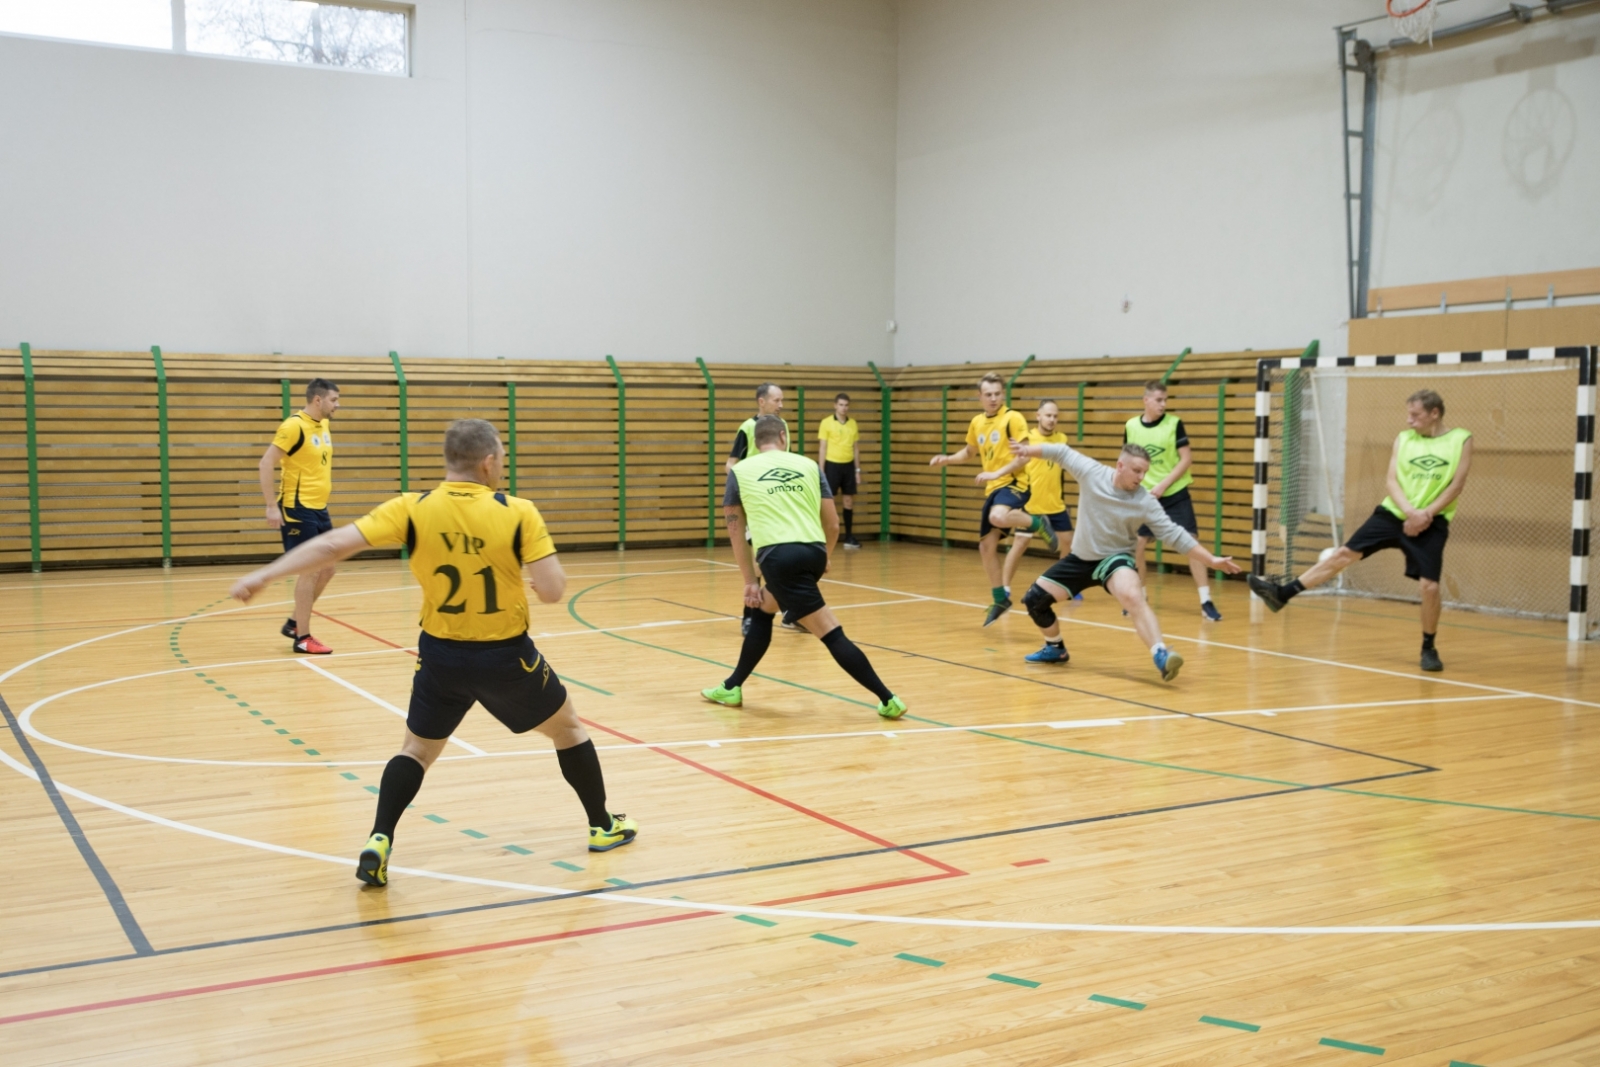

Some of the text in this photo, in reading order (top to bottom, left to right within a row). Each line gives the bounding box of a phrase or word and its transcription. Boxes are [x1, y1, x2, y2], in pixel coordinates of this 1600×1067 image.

[321, 451, 328, 466] 8
[767, 483, 804, 495] umbro
[439, 532, 485, 555] VIP
[432, 564, 506, 615] 21
